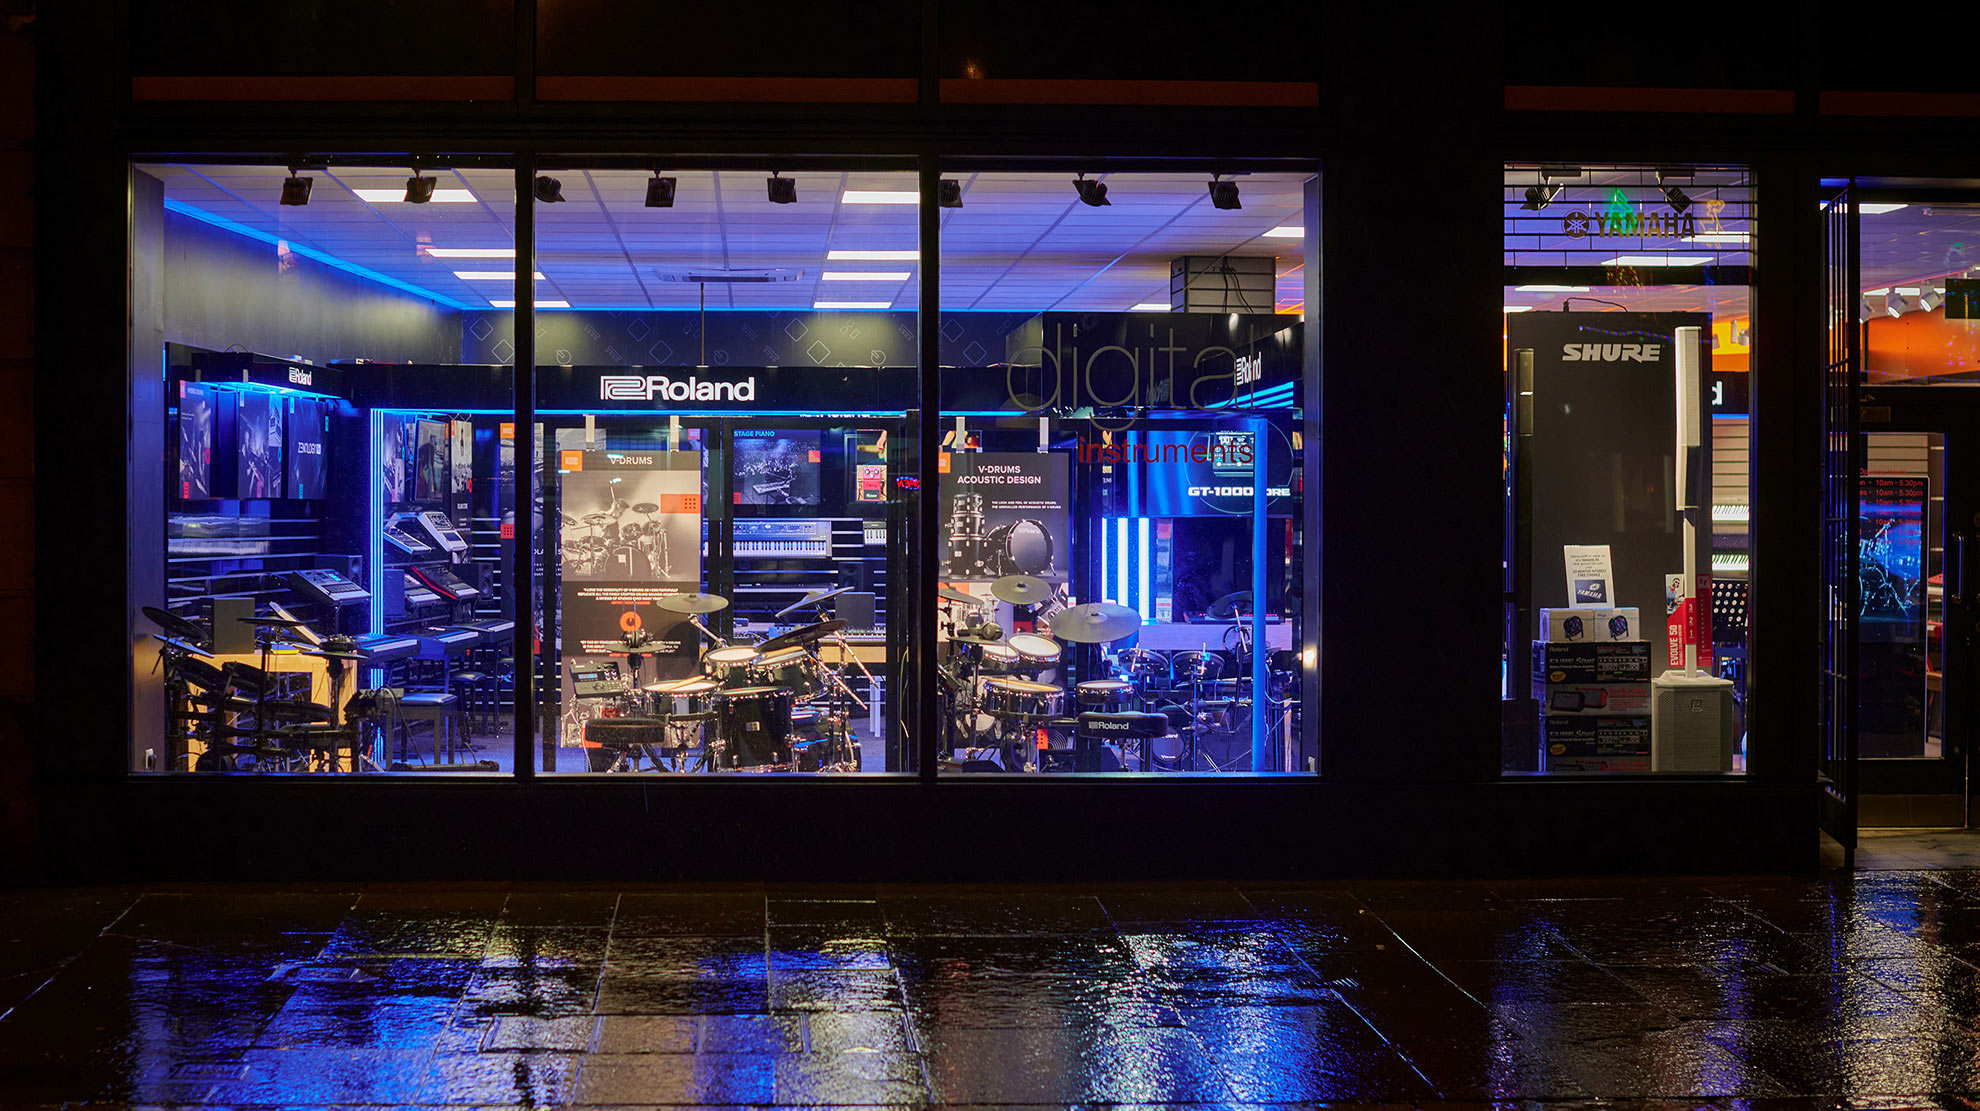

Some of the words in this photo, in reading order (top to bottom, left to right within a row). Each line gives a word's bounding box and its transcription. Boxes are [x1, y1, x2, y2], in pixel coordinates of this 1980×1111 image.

[1594, 212, 1696, 238] YAMAHA
[1562, 343, 1660, 363] SHURE
[296, 368, 312, 386] Roland
[1006, 322, 1254, 432] digital
[646, 375, 755, 402] Roland
[1078, 436, 1253, 464] instruments
[610, 456, 653, 465] V-DRUMS
[978, 466, 1021, 474] V-DRUMS
[957, 476, 1004, 484] ACOUSTIC
[1007, 476, 1041, 484] DESIGN
[1578, 589, 1602, 599] YAMAHA
[1669, 625, 1678, 635] 50
[1670, 637, 1679, 666] EVOLVE
[1098, 721, 1129, 730] Roland
